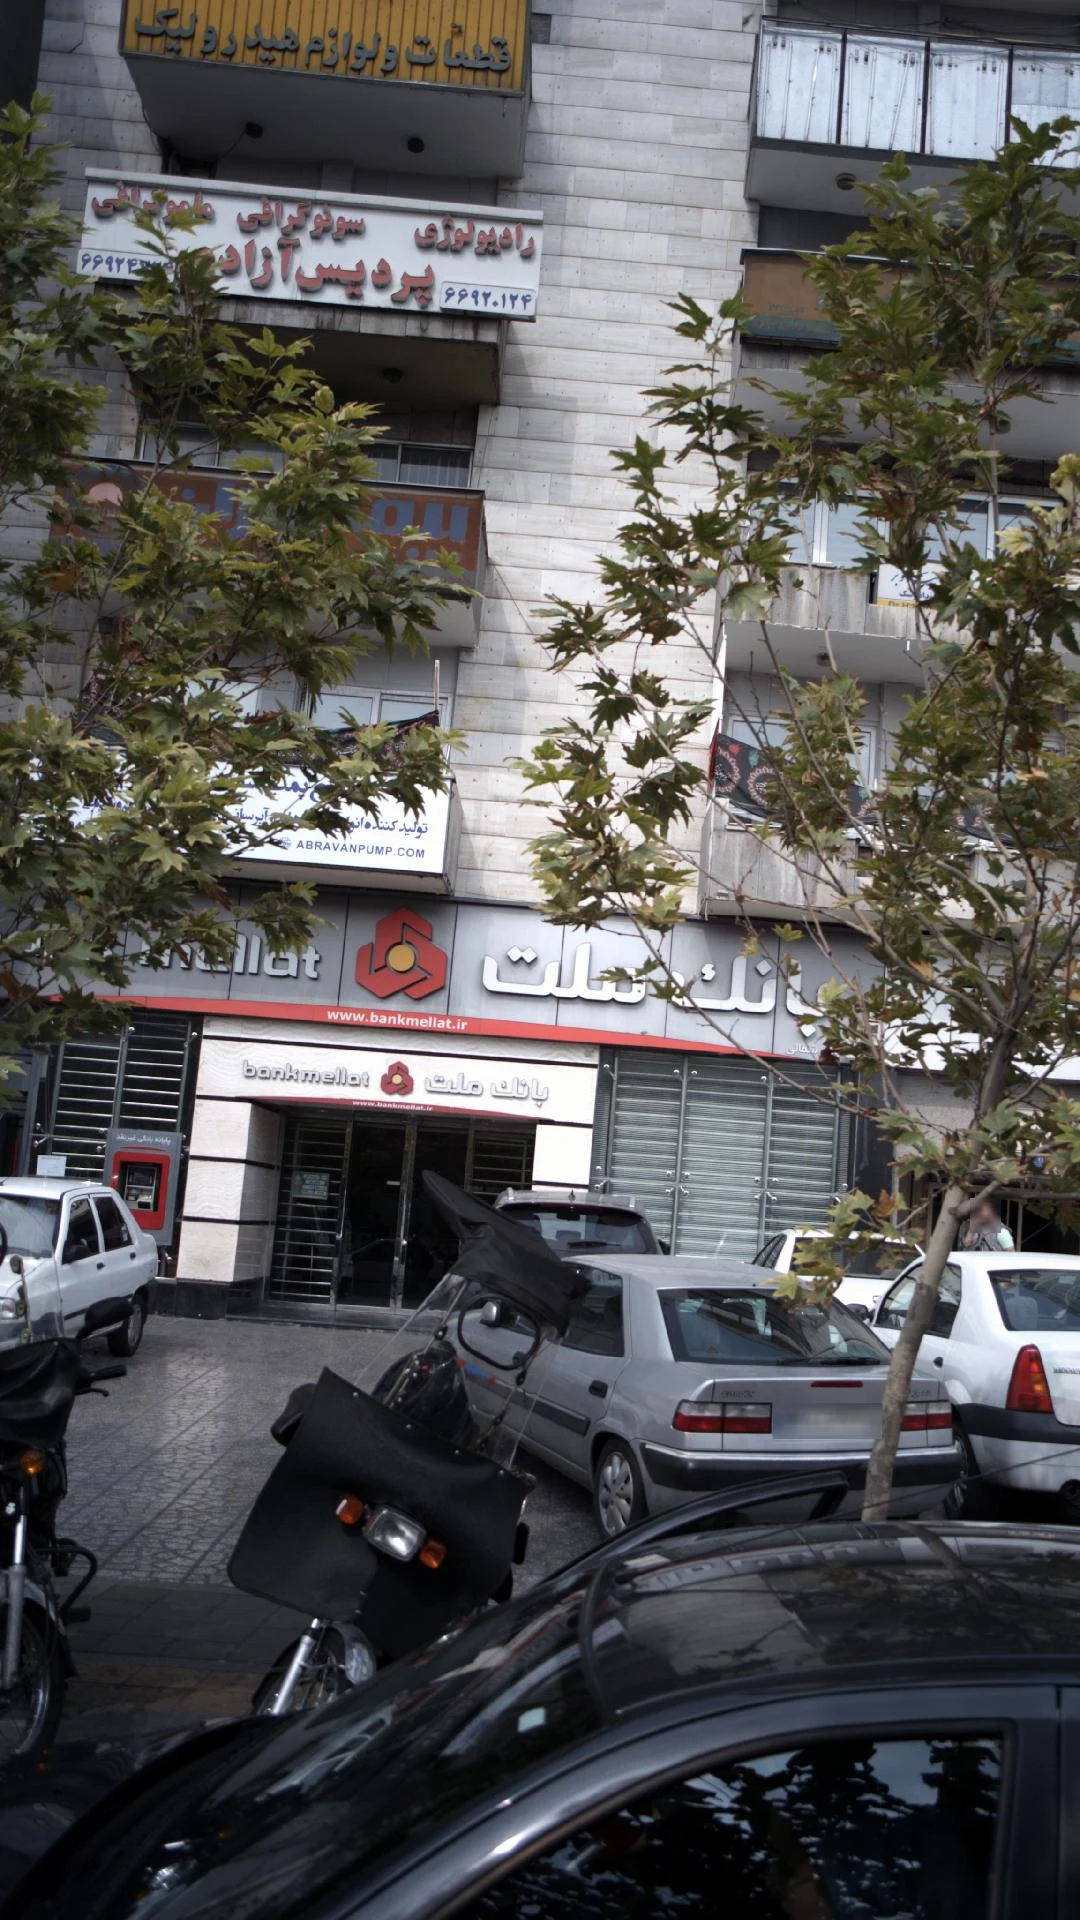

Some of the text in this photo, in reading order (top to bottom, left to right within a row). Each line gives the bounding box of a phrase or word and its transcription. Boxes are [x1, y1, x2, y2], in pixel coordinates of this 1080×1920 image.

[406, 29, 512, 72] قطعات
[236, 195, 366, 241] سونوگرافی
[414, 214, 536, 259] رادیولوژی
[81, 252, 176, 276] ۶۶۹۲۴
[295, 256, 435, 309] پردیس
[444, 287, 532, 312] ۶۶۹۲۰۱۲۴
[364, 820, 399, 832] کننده
[398, 819, 429, 839] تولید
[296, 839, 426, 859] ABRAVANPUMP.COM
[482, 942, 646, 1005] ملت
[327, 1010, 469, 1031] www.bankmellat.ir
[241, 1059, 370, 1088] bankmellat
[424, 1071, 484, 1097] ملت
